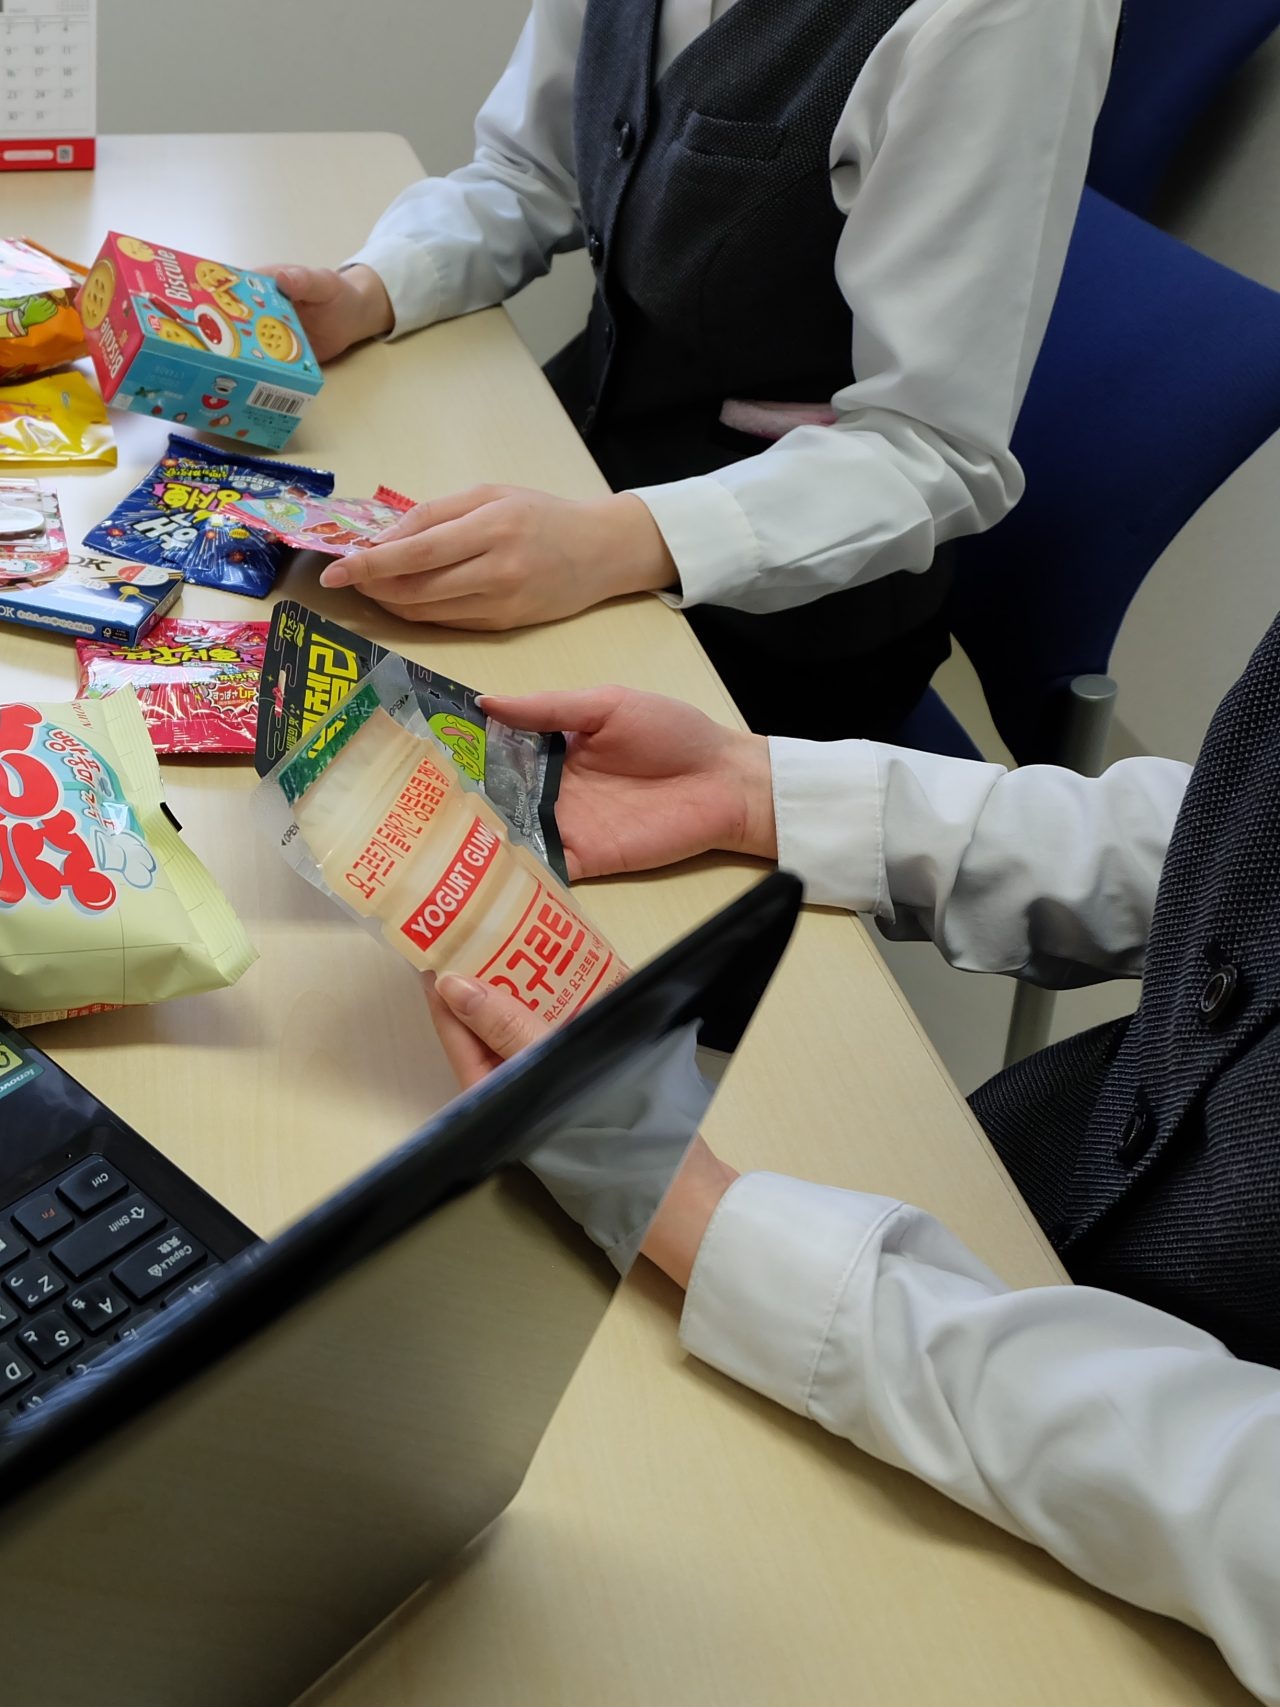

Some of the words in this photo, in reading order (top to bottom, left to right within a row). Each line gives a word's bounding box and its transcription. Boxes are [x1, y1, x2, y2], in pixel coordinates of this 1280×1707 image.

[284, 617, 297, 642] 서주
[211, 688, 239, 700] すっぱさ
[239, 686, 257, 699] UP
[388, 696, 406, 717] OPEN
[46, 728, 104, 787] 빵풍미
[345, 836, 395, 899] 요구르트가
[376, 811, 423, 859] 들어간
[410, 859, 473, 941] YOGURT
[542, 988, 573, 1023] 파스퇴르
[92, 1172, 109, 1188] Ctrl
[42, 1208, 56, 1219] Fn
[109, 1214, 131, 1232] Shift
[161, 1245, 192, 1271] CapsLk
[38, 1276, 53, 1292] Z
[99, 1299, 113, 1313] A
[54, 1330, 69, 1347] S
[5, 1363, 21, 1379] D
